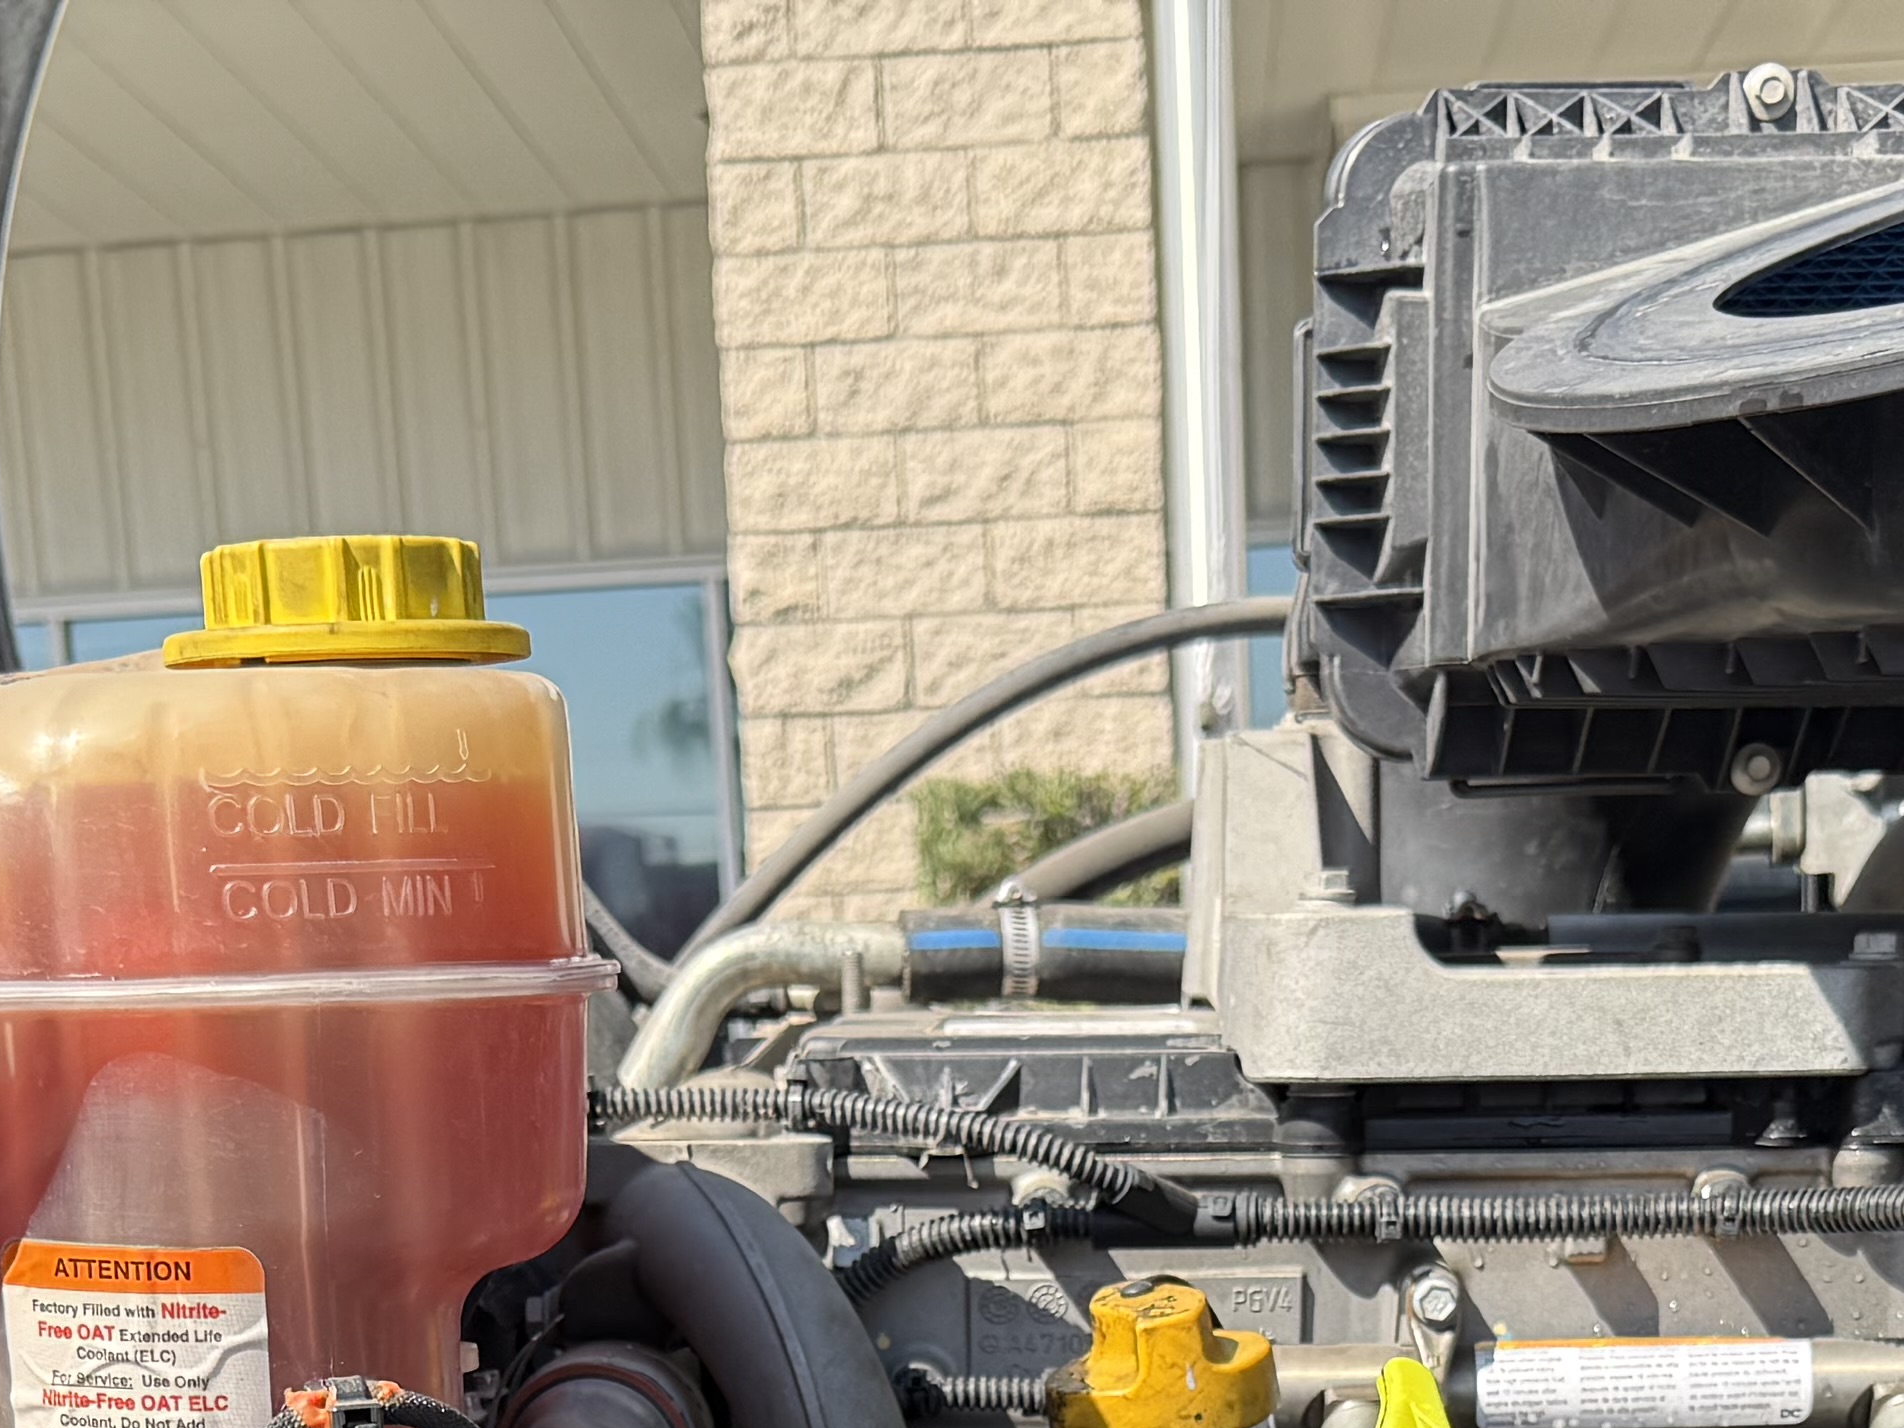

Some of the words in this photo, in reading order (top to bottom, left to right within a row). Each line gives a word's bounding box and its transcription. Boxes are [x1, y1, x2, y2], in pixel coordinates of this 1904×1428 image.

[207, 793, 345, 838] COLD
[371, 792, 448, 834] FILL
[223, 878, 357, 920] COLD
[382, 875, 452, 916] MIN
[54, 1258, 191, 1281] ATTENTION
[32, 1299, 78, 1318] Factory
[83, 1302, 121, 1317] Filled
[124, 1304, 156, 1318] with
[161, 1302, 227, 1320] Nitrite-
[38, 1321, 72, 1339] Free
[77, 1325, 115, 1342] OAT
[120, 1329, 189, 1342] Extended
[194, 1330, 223, 1342] Life
[76, 1346, 132, 1362] Coolant
[134, 1348, 176, 1365] (ELC)
[76, 1373, 133, 1388] Service:
[141, 1375, 170, 1388] Use
[174, 1376, 210, 1390] Only
[42, 1388, 136, 1410] Nitrite-Free
[141, 1395, 184, 1412] OAT
[189, 1395, 229, 1412] ELC
[1780, 1408, 1802, 1419] DC
